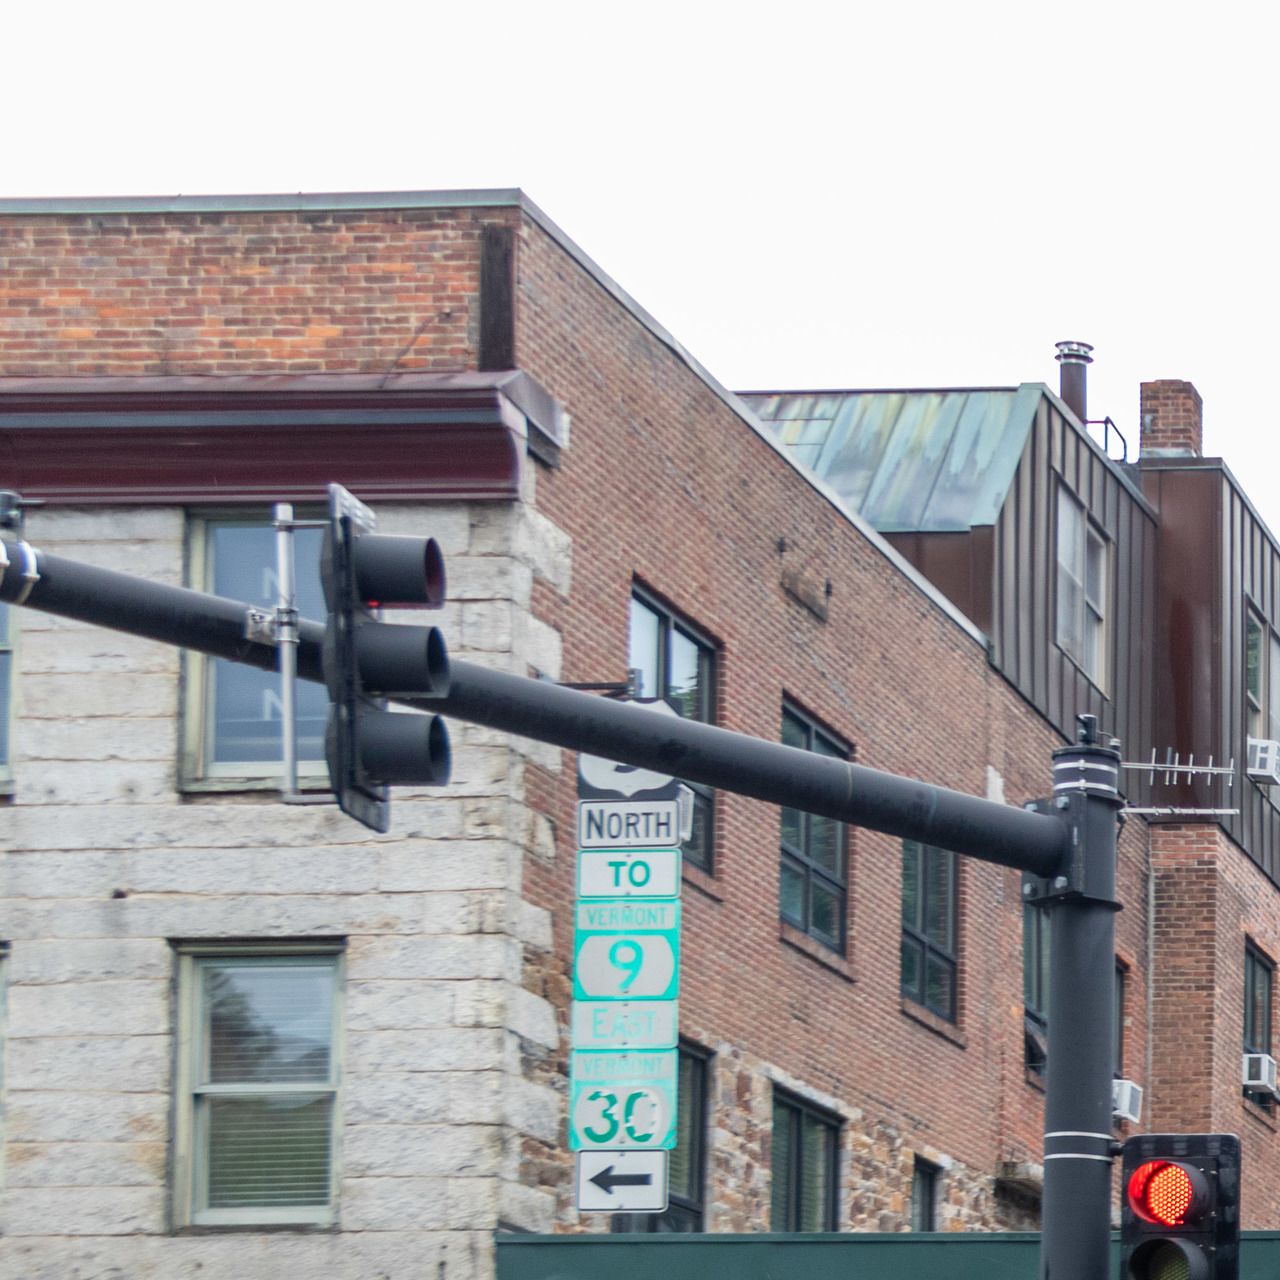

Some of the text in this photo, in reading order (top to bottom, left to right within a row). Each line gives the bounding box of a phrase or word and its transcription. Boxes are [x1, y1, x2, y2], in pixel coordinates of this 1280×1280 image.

[586, 808, 672, 839] NORTH
[608, 860, 652, 888] TO
[585, 906, 668, 927] VERMONT
[608, 938, 645, 991] 9
[591, 1008, 657, 1040] EAST
[583, 1090, 661, 1144] 30
